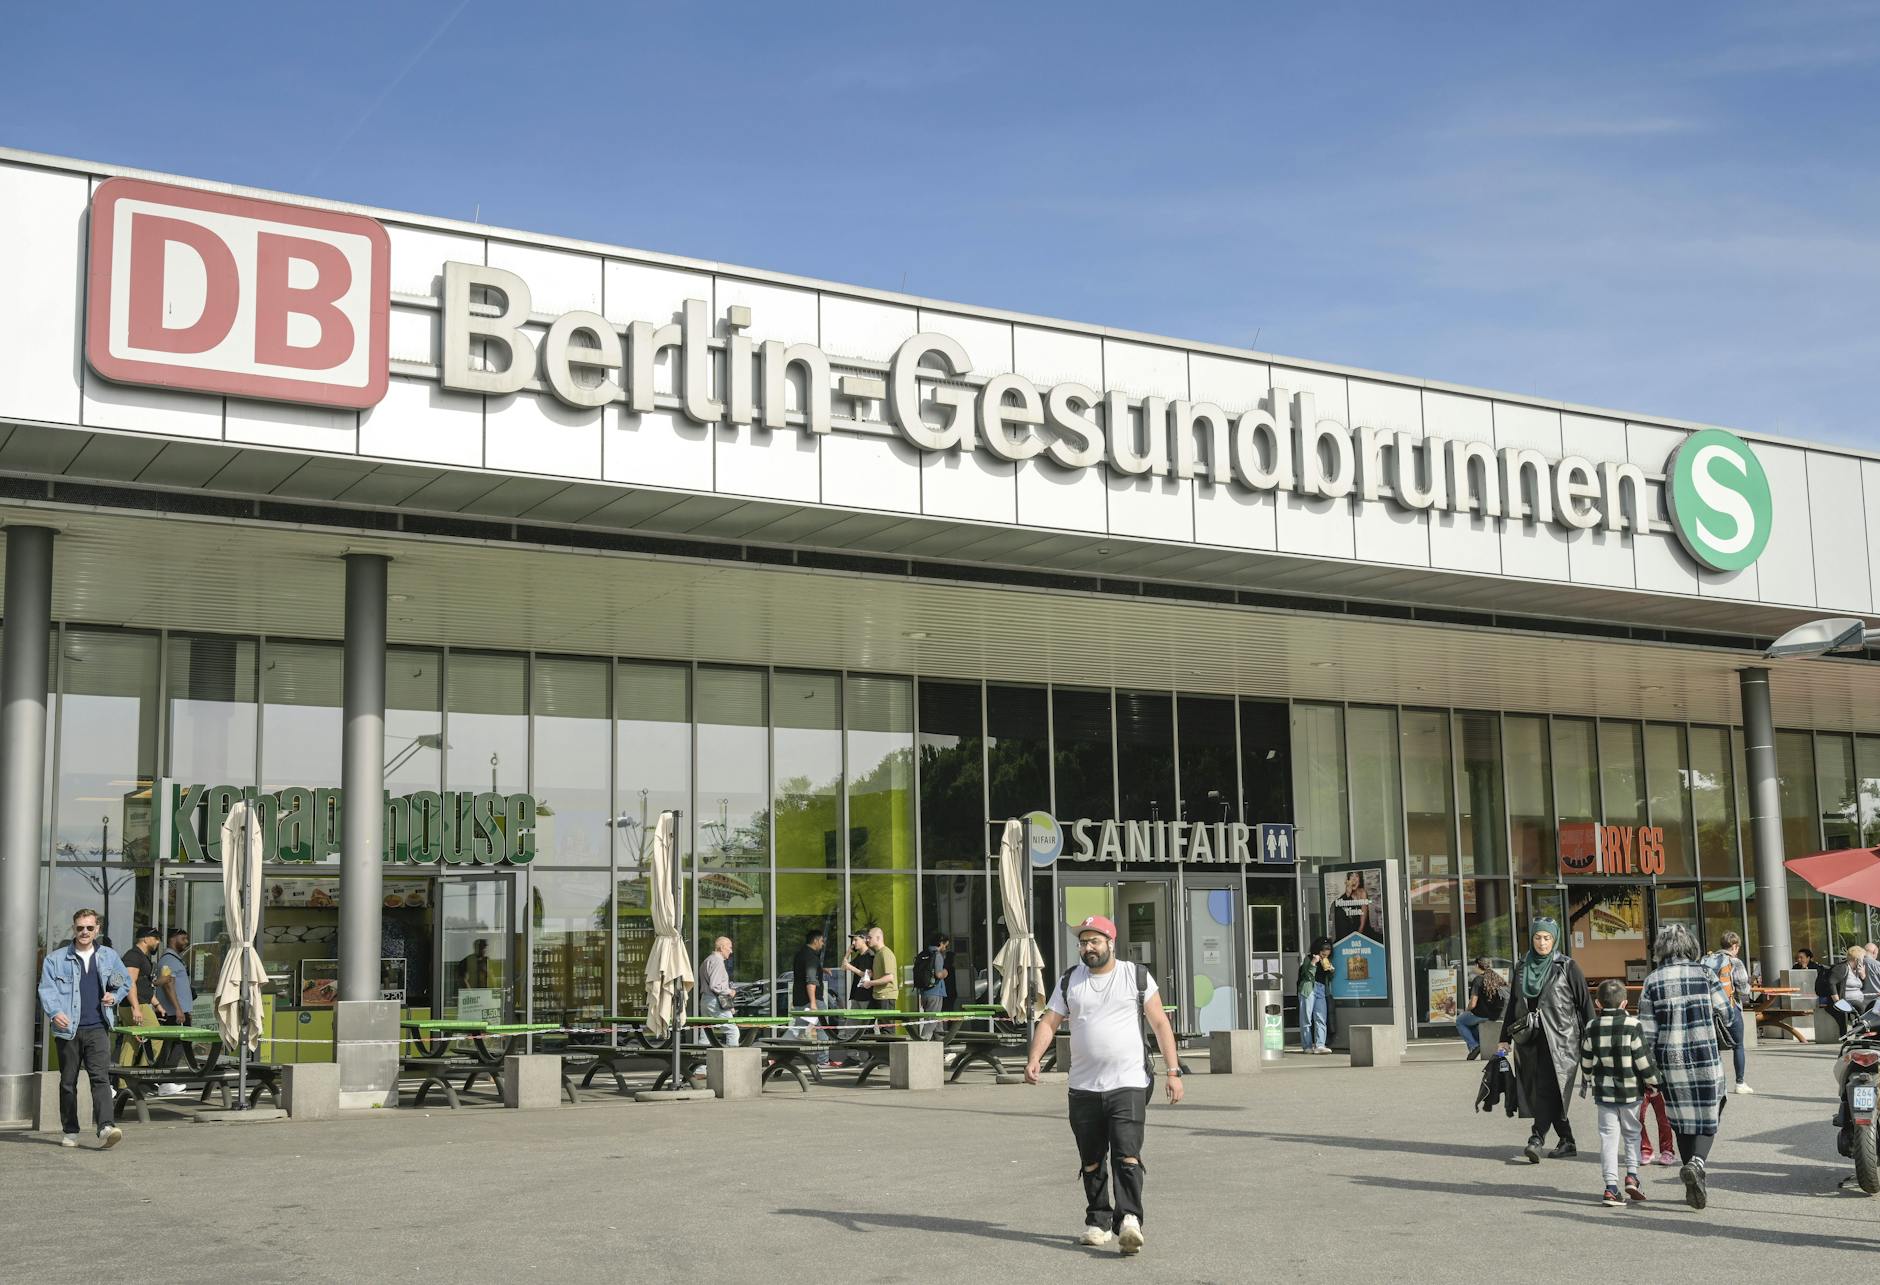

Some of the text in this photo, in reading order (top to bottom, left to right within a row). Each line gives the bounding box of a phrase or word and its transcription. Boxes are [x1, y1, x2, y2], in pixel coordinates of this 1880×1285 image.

[127, 212, 355, 371] DB
[442, 260, 1649, 535] Berlin-Gesundbrunnen
[1691, 444, 1755, 554] S
[1032, 835, 1056, 845] NIFAIR
[1072, 818, 1251, 864] SANIFAIR
[1600, 825, 1665, 875] RRY 65
